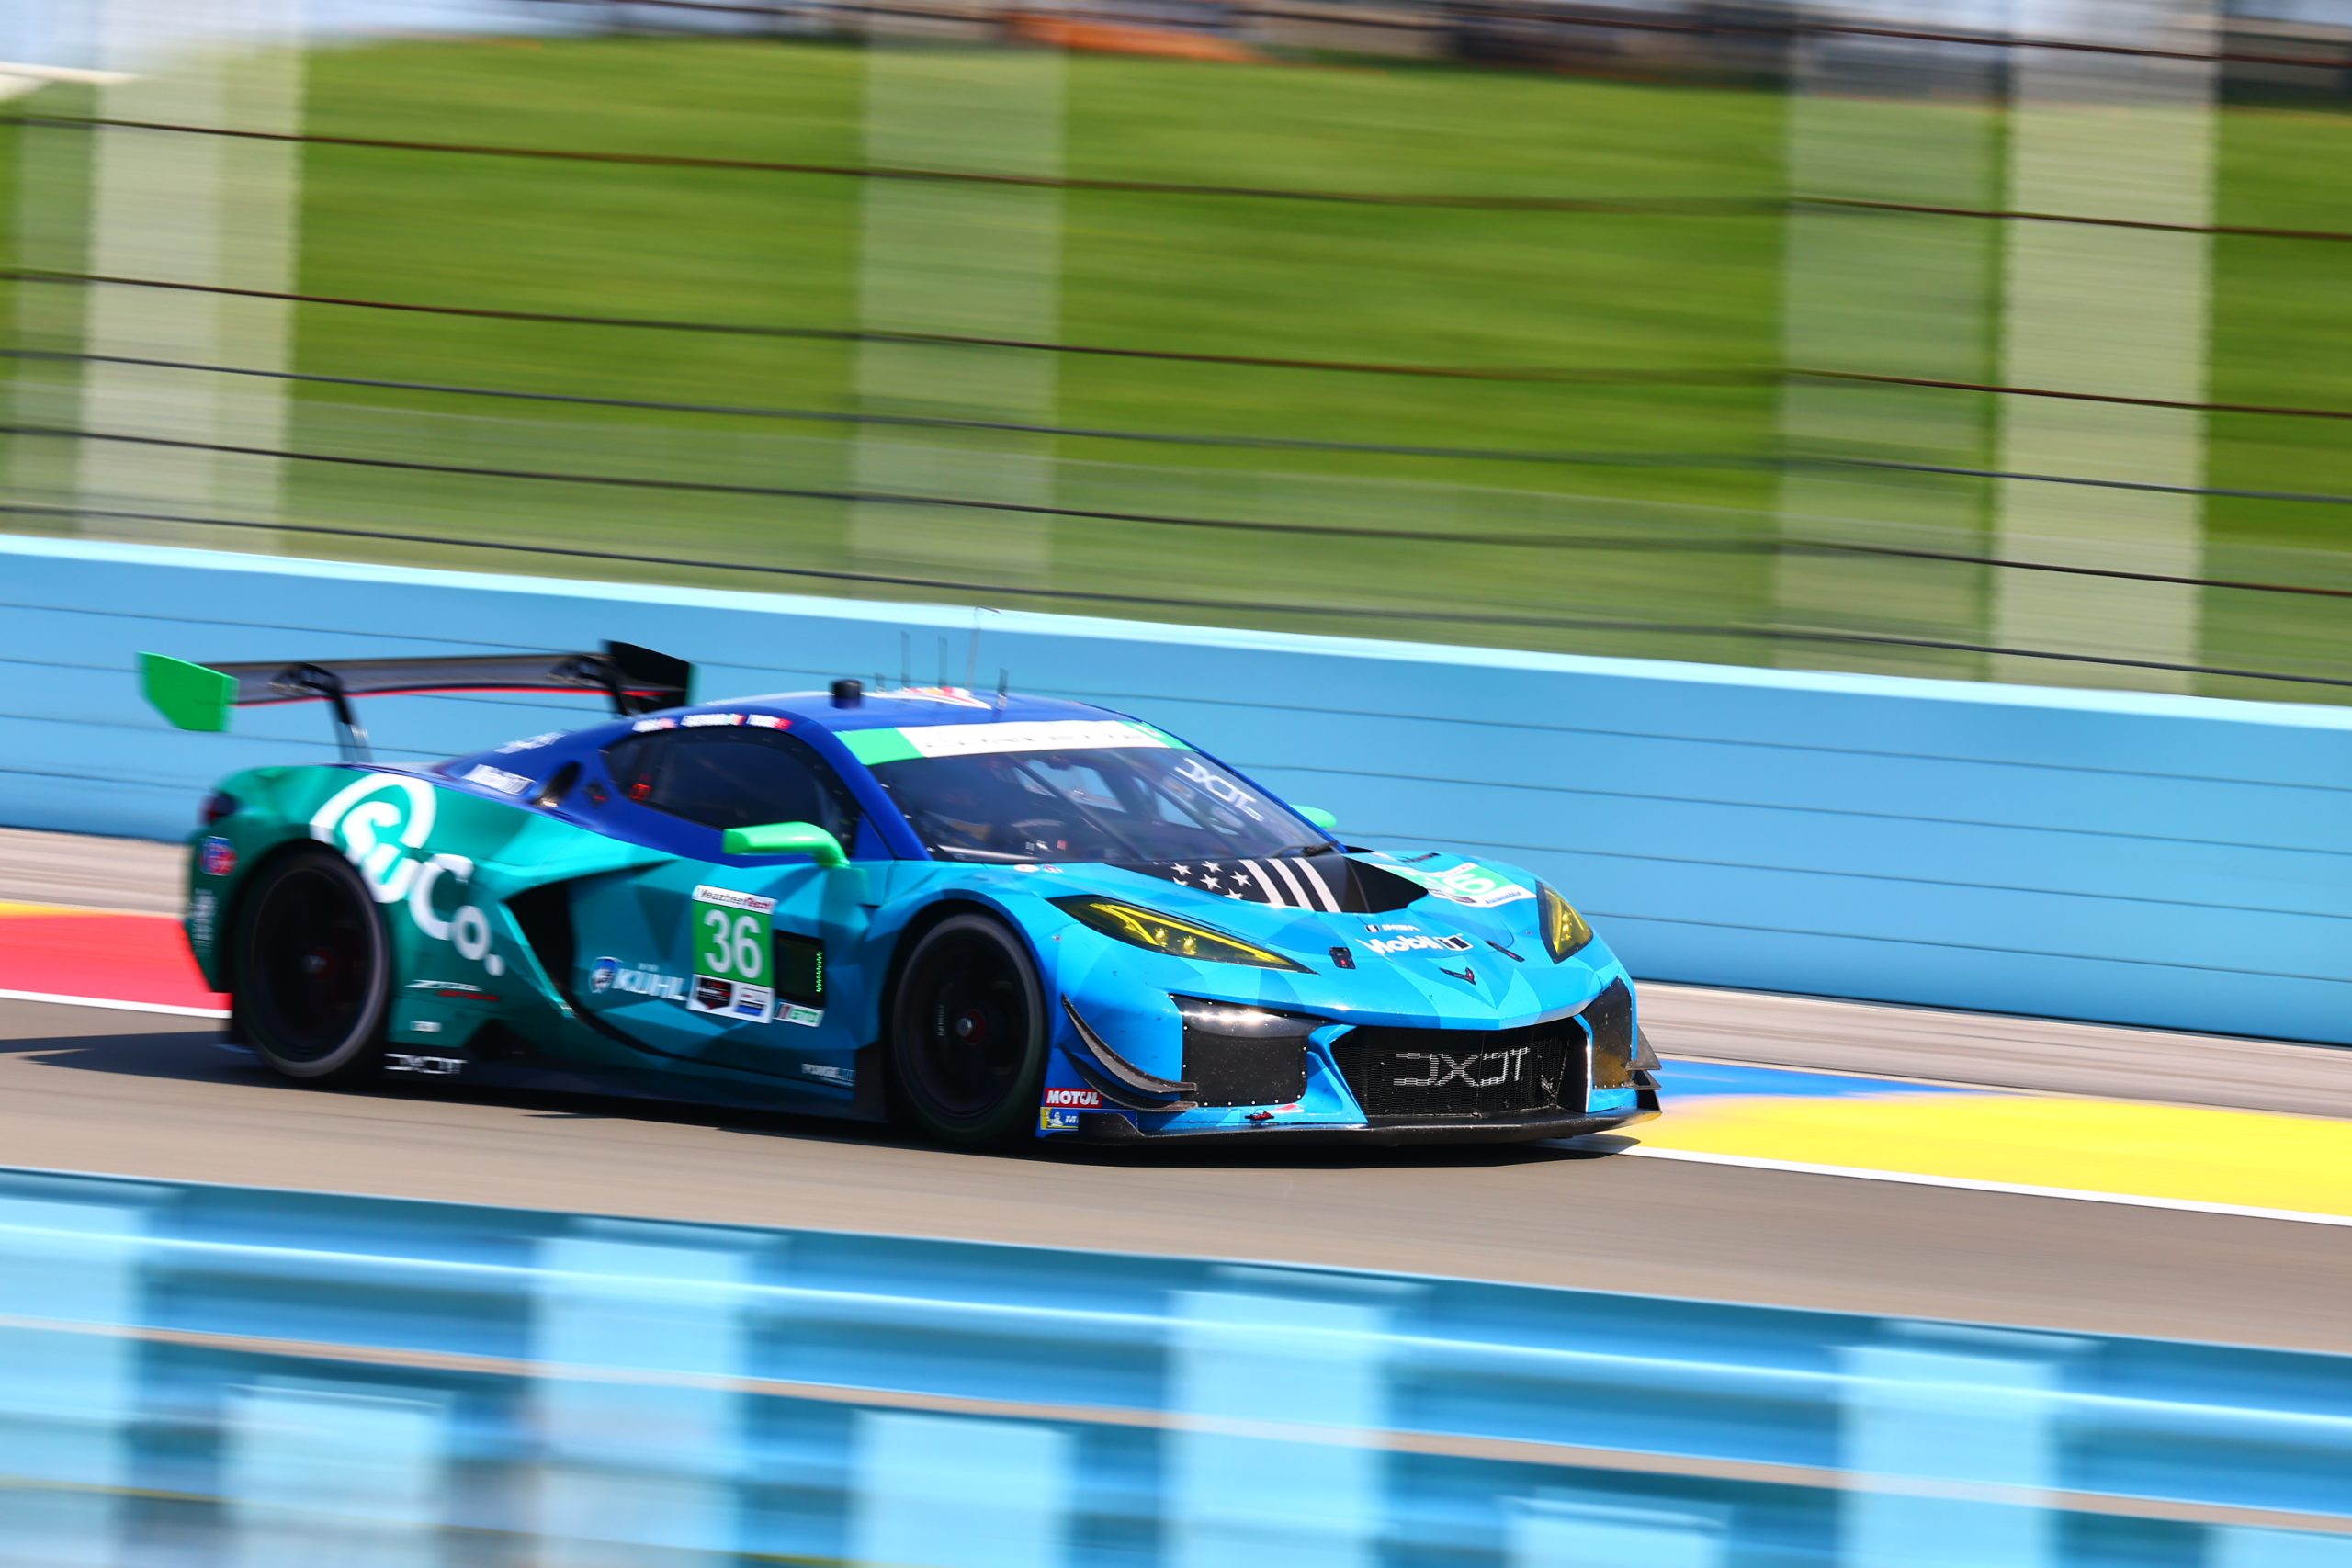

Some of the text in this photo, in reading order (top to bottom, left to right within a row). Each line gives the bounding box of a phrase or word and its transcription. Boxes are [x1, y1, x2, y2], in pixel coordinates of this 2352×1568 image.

[704, 909, 763, 979] 36
[1355, 935, 1444, 955] Mobil
[1046, 1089, 1100, 1105] MOTUL
